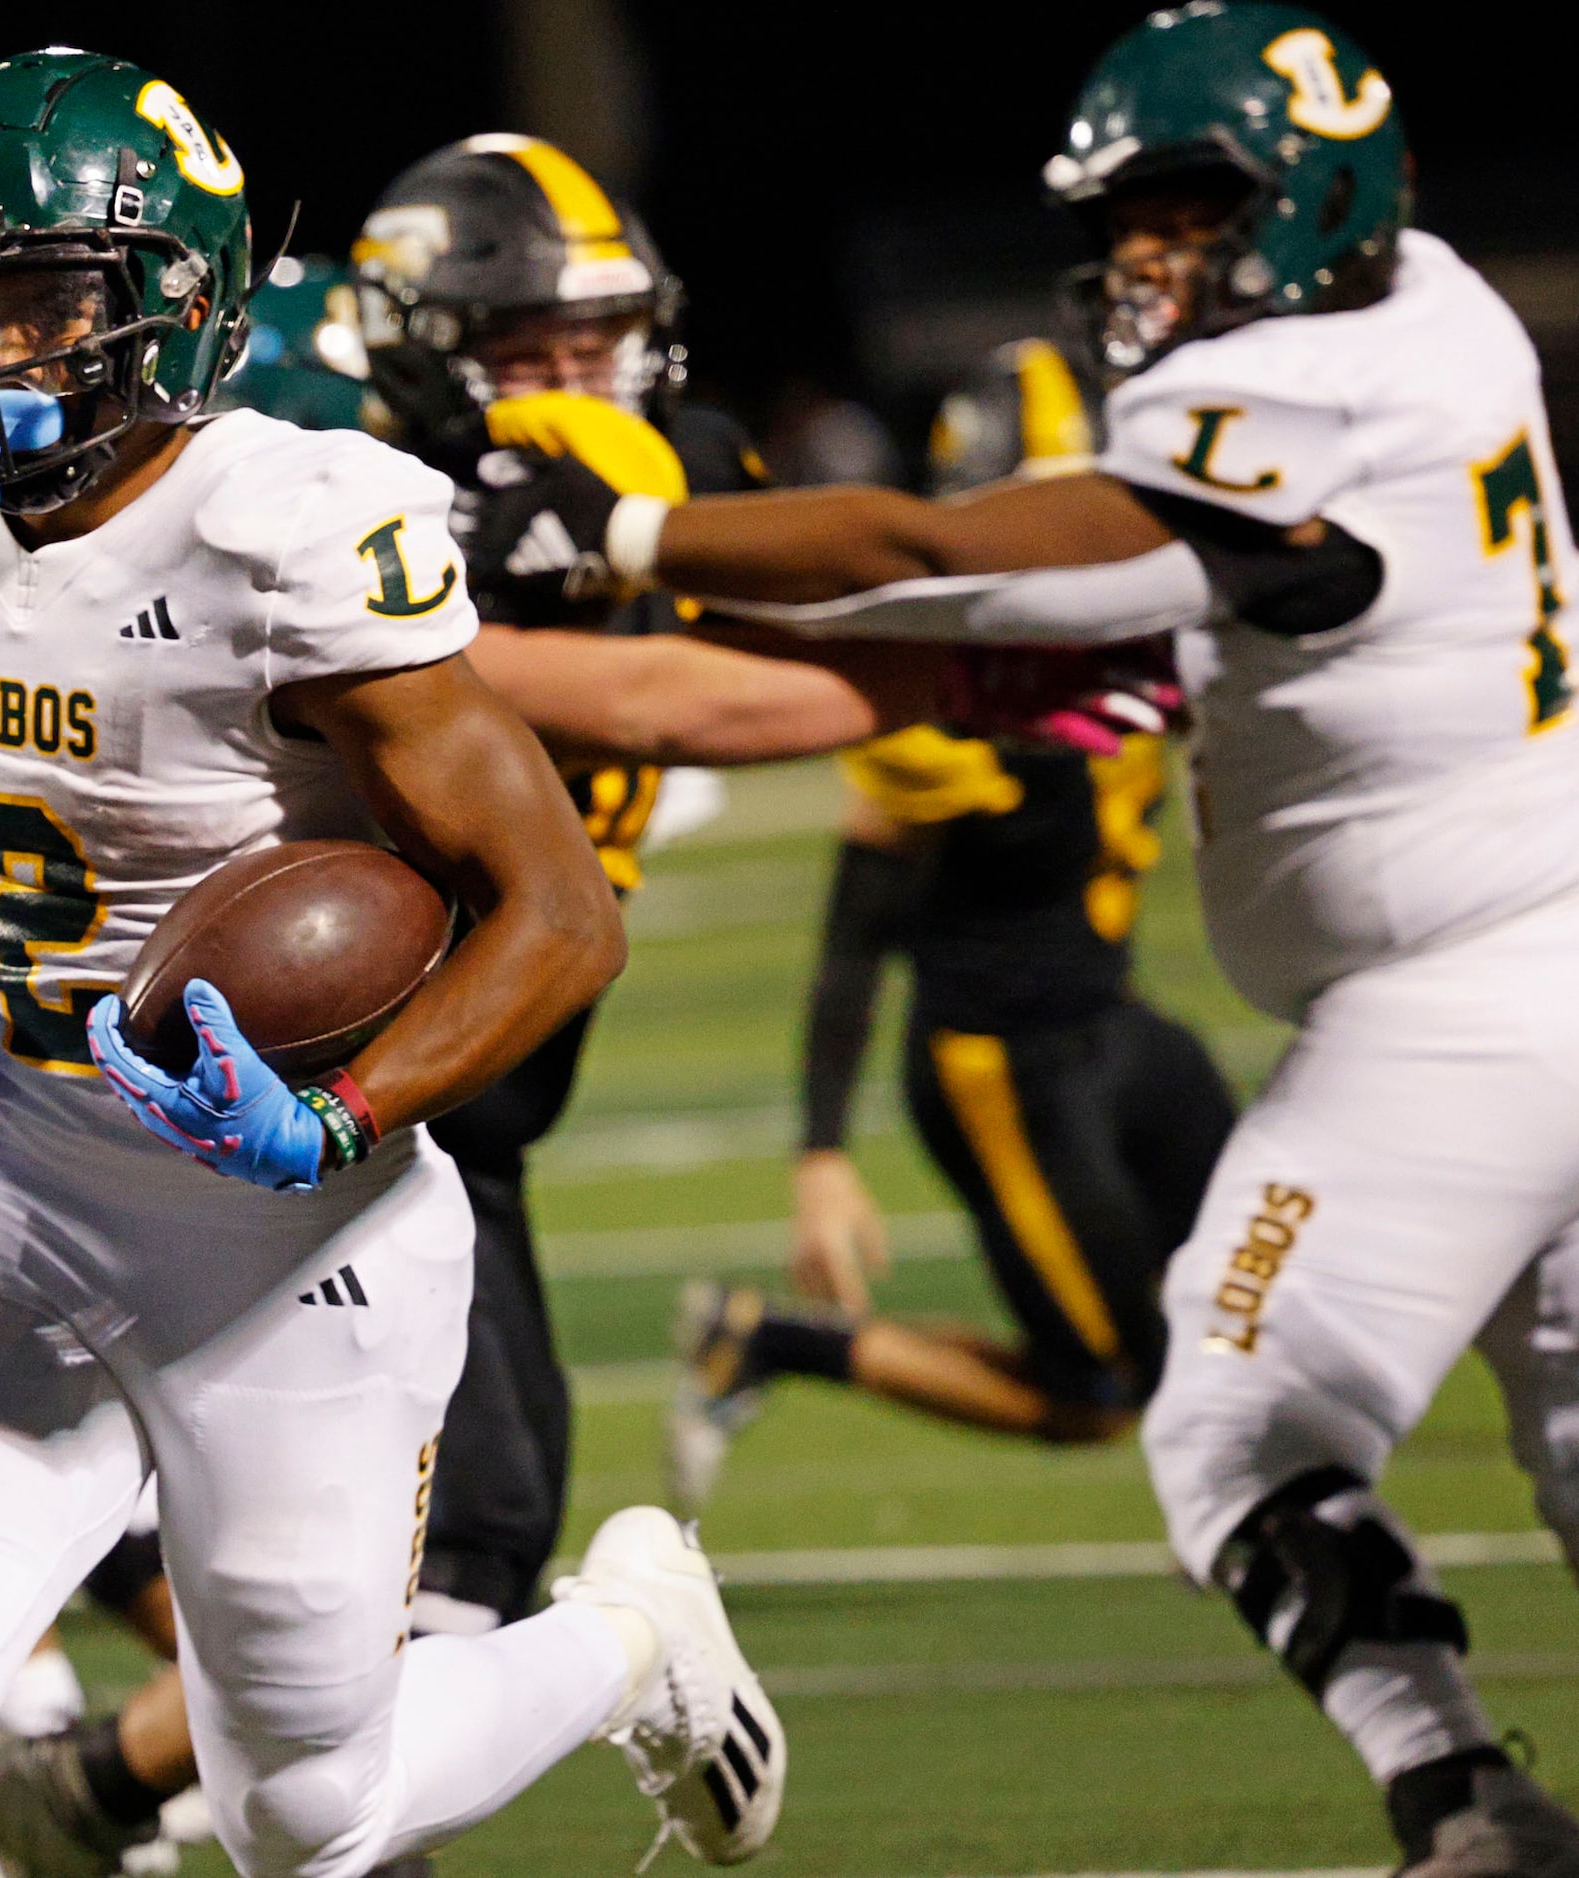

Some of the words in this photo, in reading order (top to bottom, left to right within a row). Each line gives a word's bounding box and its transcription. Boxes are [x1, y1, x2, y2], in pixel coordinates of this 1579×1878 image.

[1173, 405, 1284, 492] L
[354, 512, 458, 620] L
[1205, 1182, 1315, 1358] LOBOS
